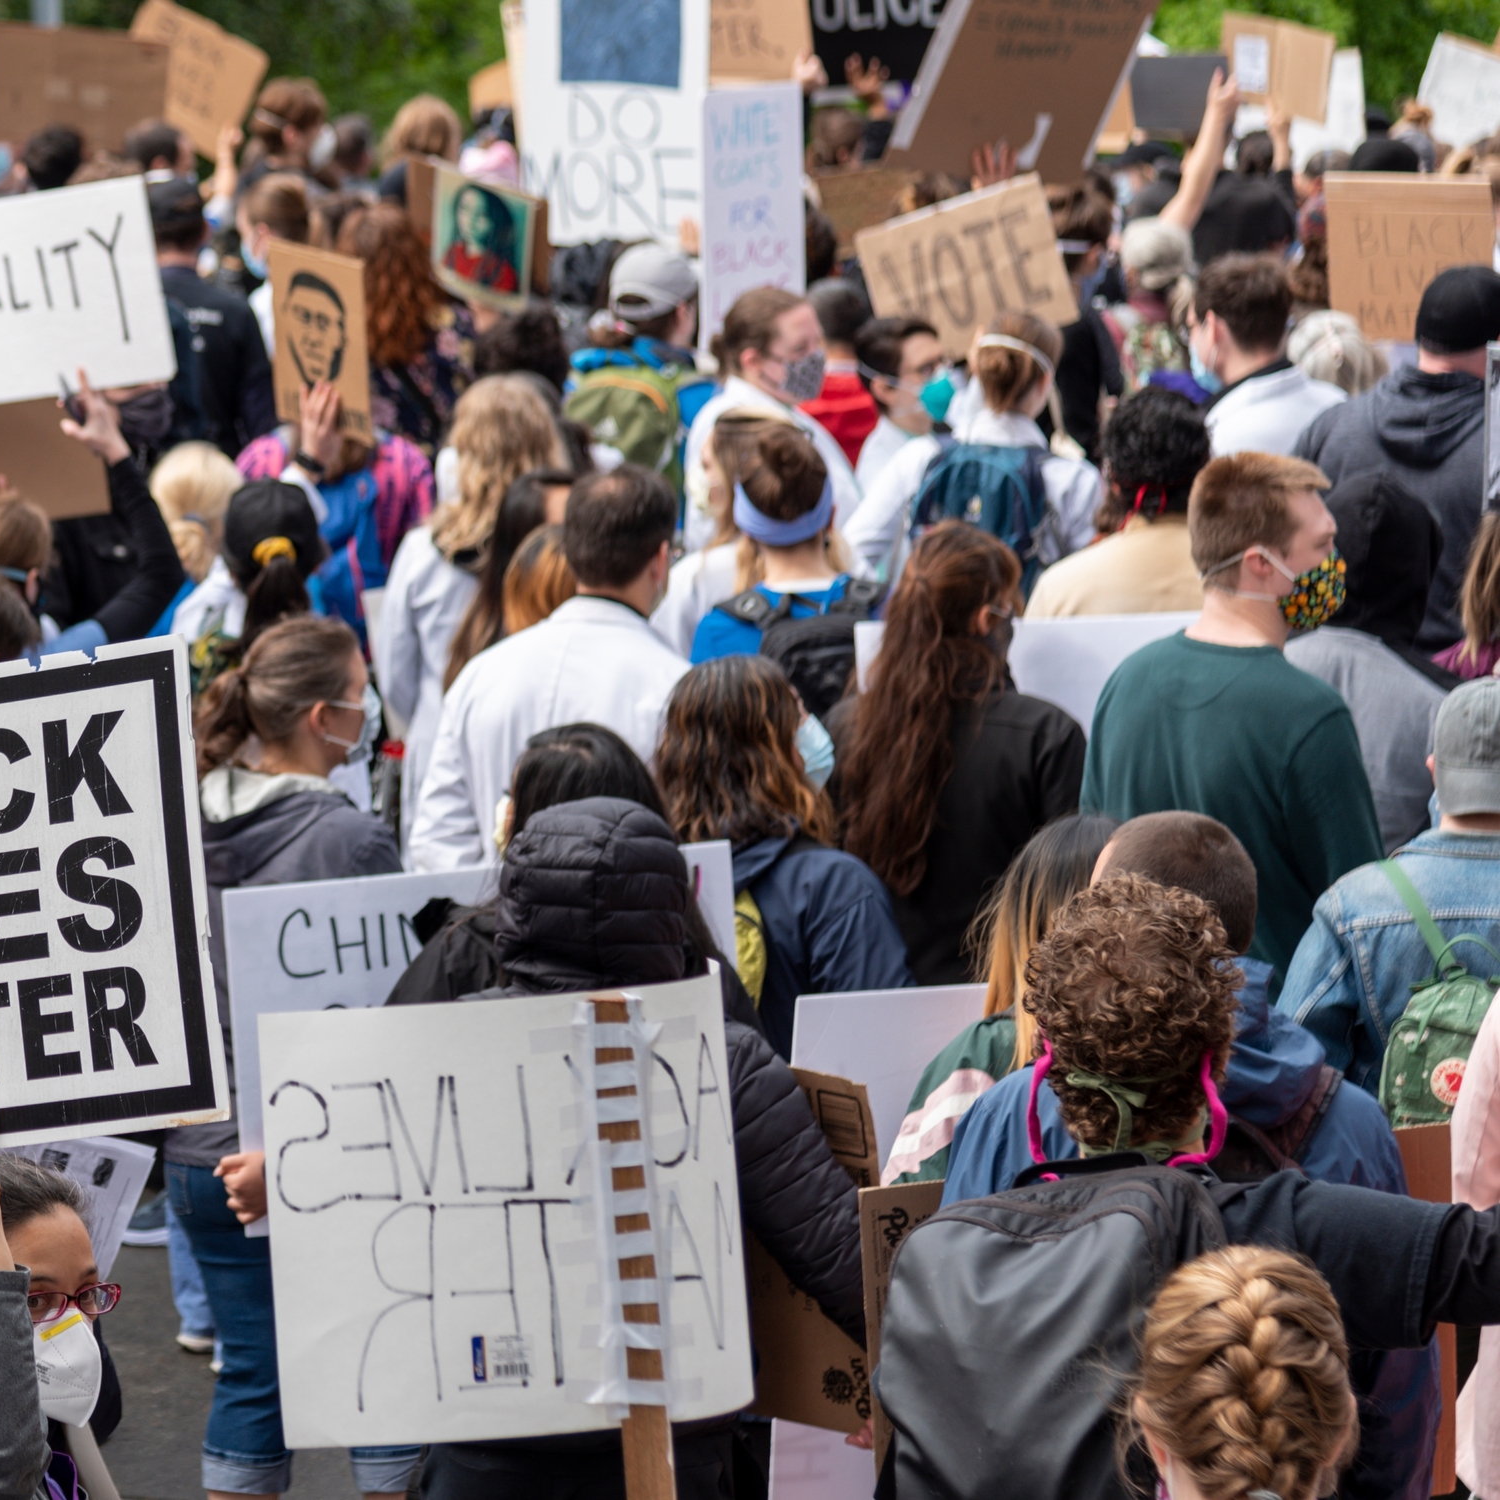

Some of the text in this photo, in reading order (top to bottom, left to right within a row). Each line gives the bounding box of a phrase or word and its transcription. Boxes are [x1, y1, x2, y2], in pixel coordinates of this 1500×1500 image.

[568, 85, 663, 149] DO
[522, 146, 698, 236] MORE
[729, 195, 776, 232] FOR
[712, 235, 794, 276] BLACK
[1353, 214, 1480, 259] BLACK
[879, 204, 1053, 328] VOTE
[1369, 260, 1442, 296] LIV
[278, 908, 424, 979] CHIN
